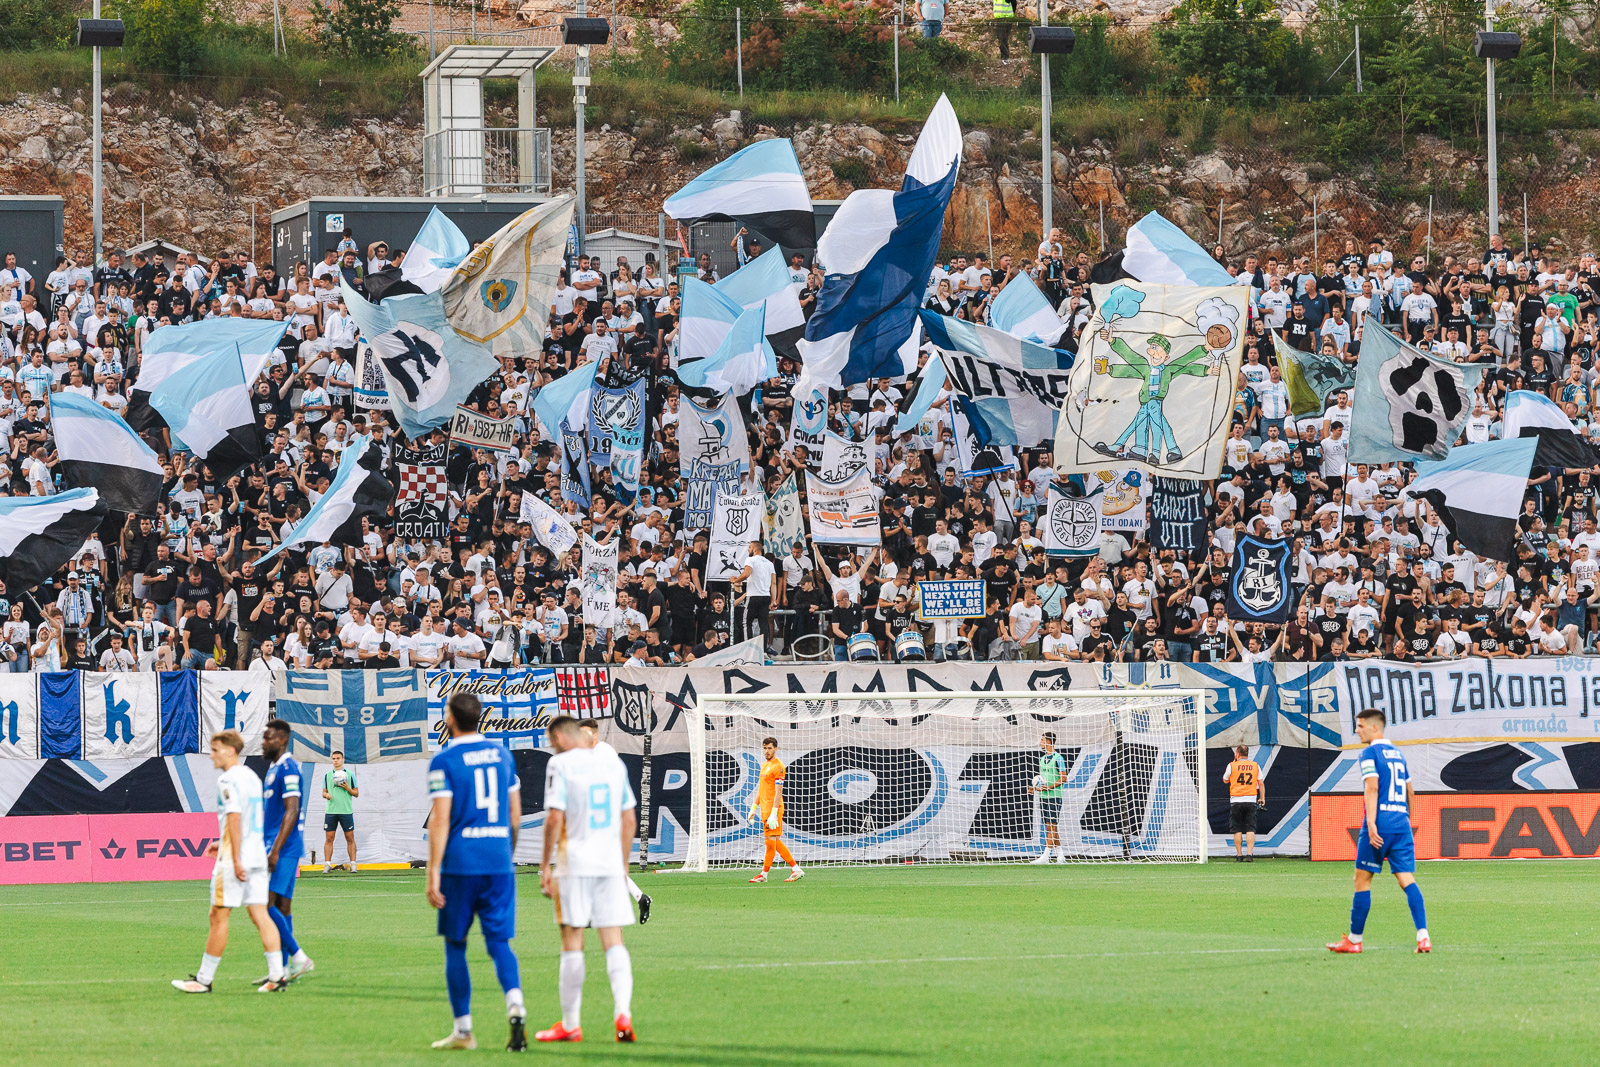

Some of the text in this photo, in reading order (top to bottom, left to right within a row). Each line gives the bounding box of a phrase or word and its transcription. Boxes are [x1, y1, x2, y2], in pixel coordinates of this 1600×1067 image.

[1293, 323, 1307, 335] RI
[455, 413, 469, 434] RI
[1075, 503, 1095, 521] RIJEKA
[396, 522, 449, 538] CROATI
[1075, 525, 1094, 545] SINCE
[922, 582, 981, 592] THIS TIME
[1253, 578, 1267, 588] RI
[952, 591, 981, 599] YEAR
[966, 598, 981, 607] BE
[924, 607, 982, 616] CHAMPIONS
[428, 672, 554, 699] United colors
[1344, 665, 1438, 735] nema
[1449, 657, 1567, 713] zakona
[476, 706, 552, 734] Armada
[1502, 713, 1568, 734] armada
[1237, 772, 1253, 785] 42
[1387, 762, 1406, 802] 15
[474, 766, 499, 823] 4
[589, 783, 612, 829] 9
